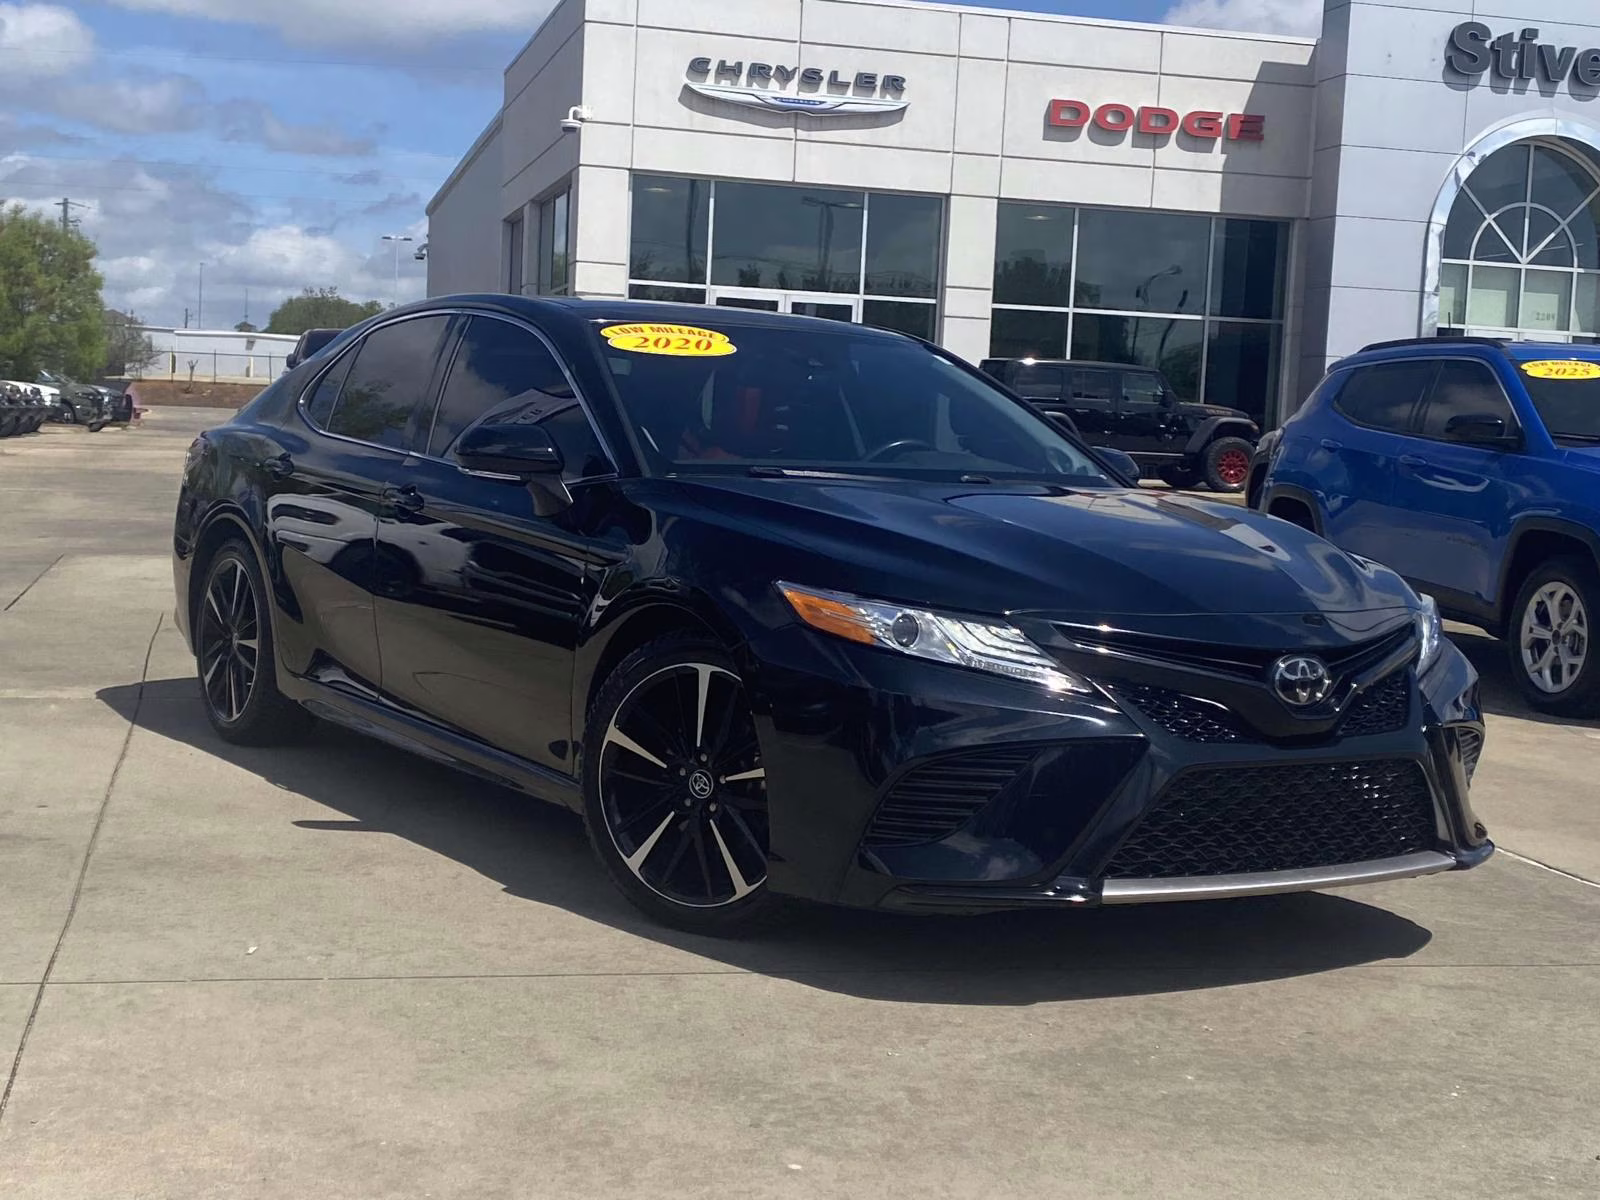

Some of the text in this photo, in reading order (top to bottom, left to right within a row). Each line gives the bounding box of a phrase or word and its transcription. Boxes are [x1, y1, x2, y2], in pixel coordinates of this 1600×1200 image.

[687, 57, 907, 91] CHRYSLER
[1047, 98, 1266, 141] DODGE
[610, 326, 714, 339] LOW MILEAGE
[634, 336, 712, 351] 2020
[1543, 368, 1591, 376] 2025
